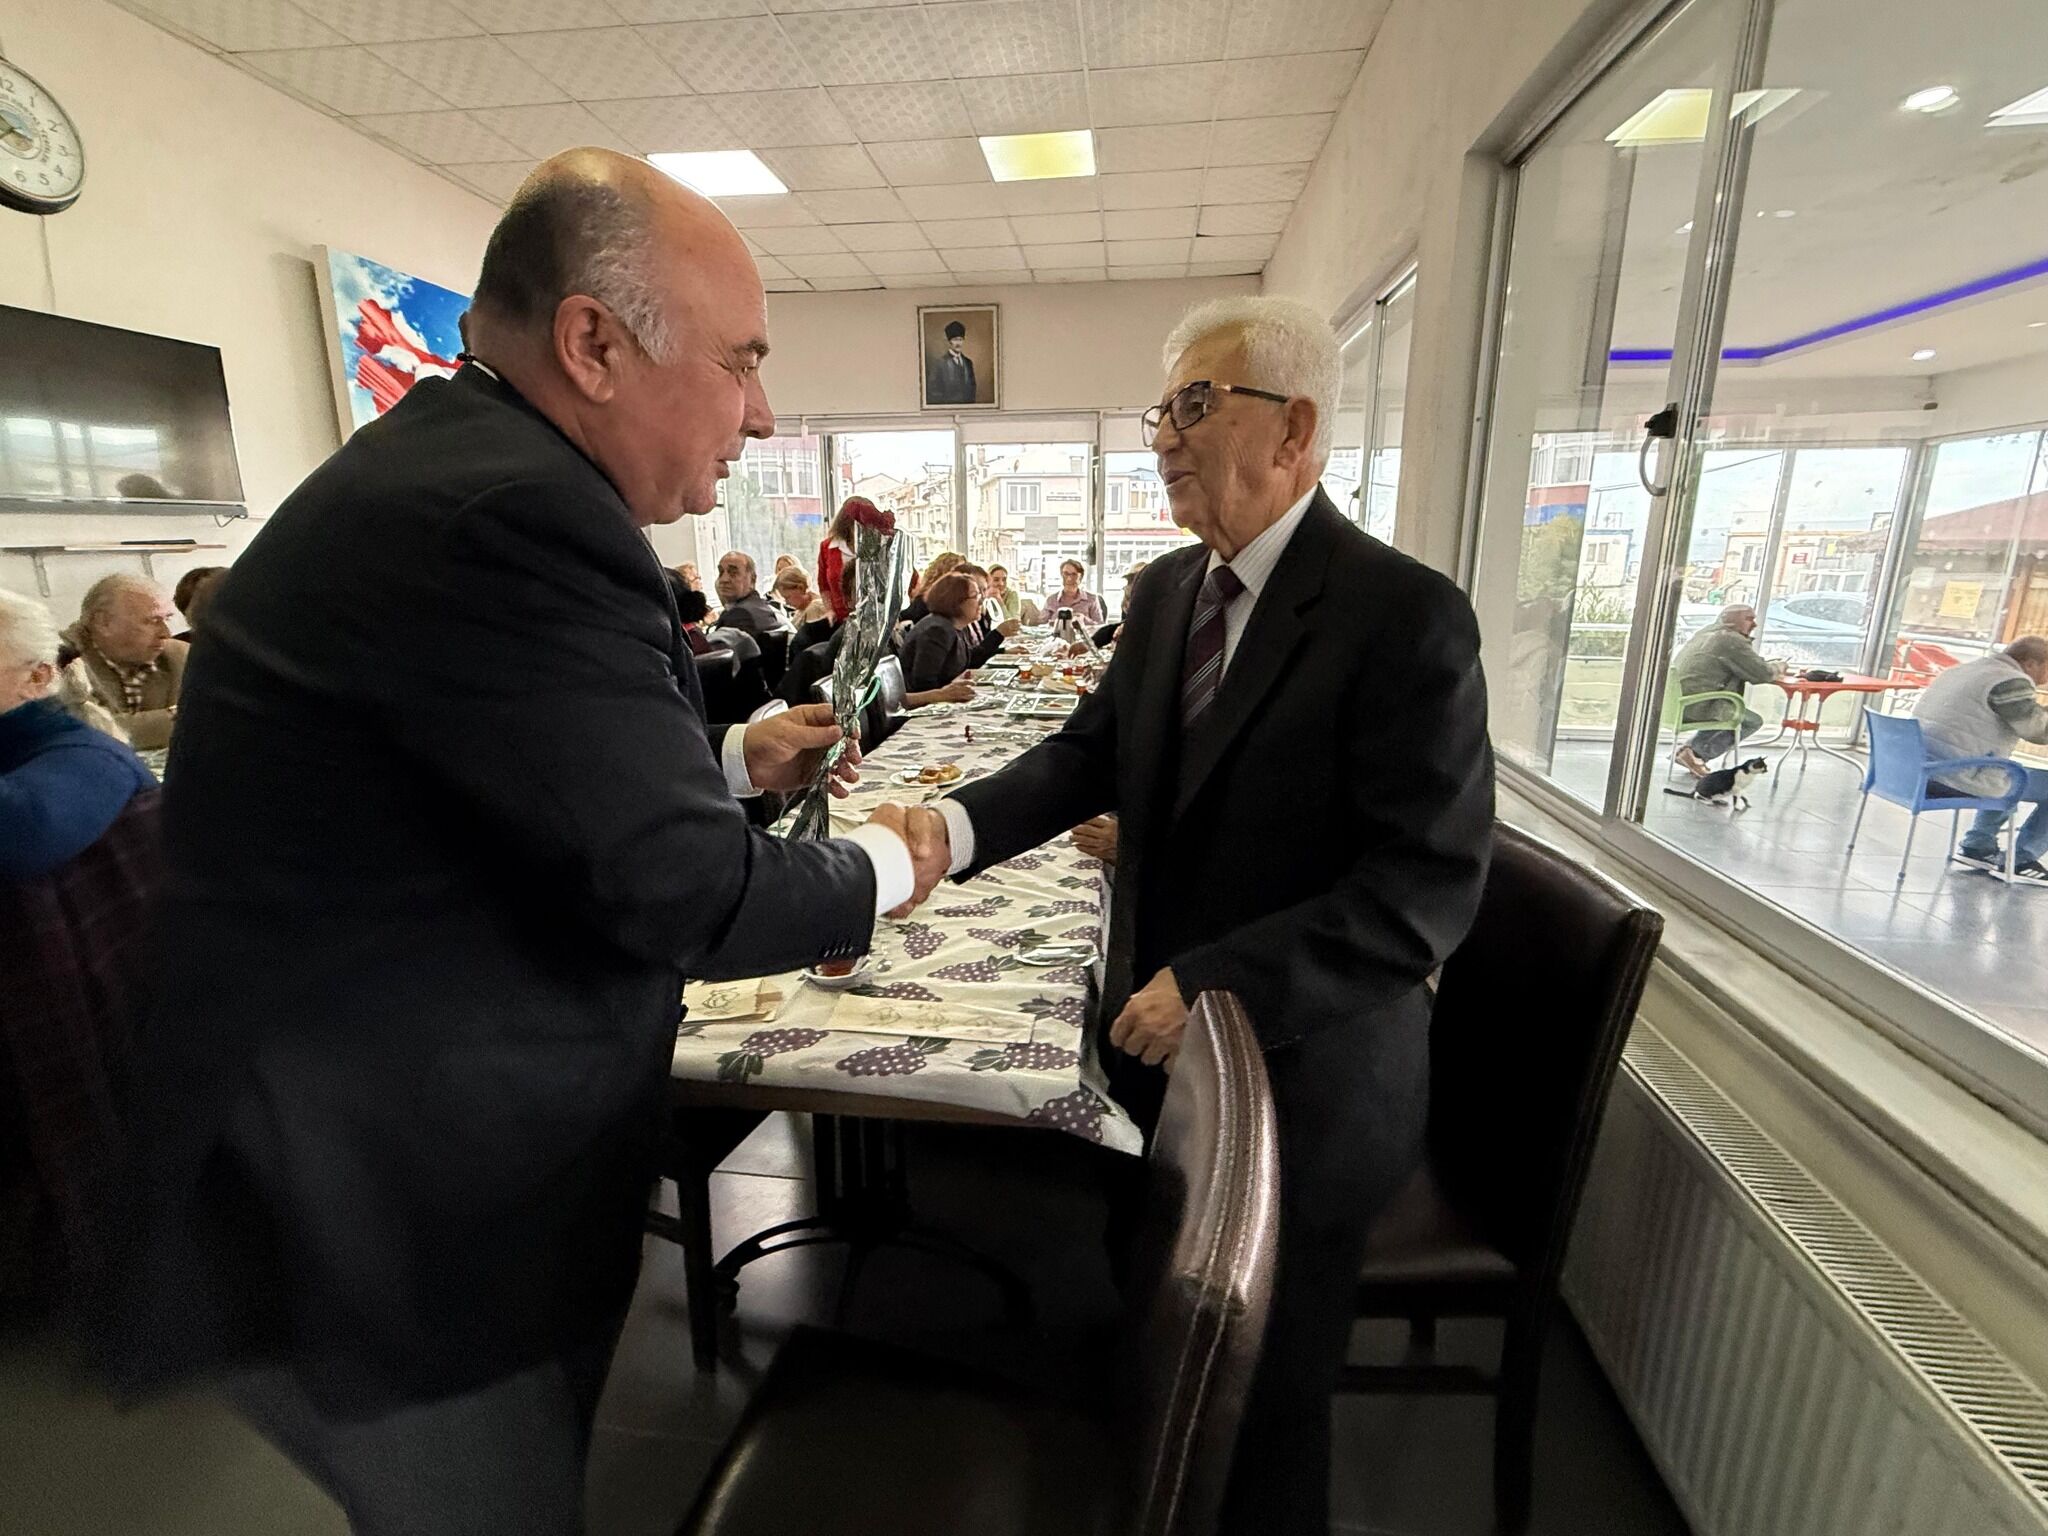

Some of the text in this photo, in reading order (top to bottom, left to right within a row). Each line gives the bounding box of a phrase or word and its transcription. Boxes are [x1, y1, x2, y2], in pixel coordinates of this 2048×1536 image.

[48, 119, 58, 133] 2
[58, 144, 69, 157] 3
[15, 170, 26, 182] 6
[54, 164, 64, 176] 4
[39, 172, 50, 185] 5
